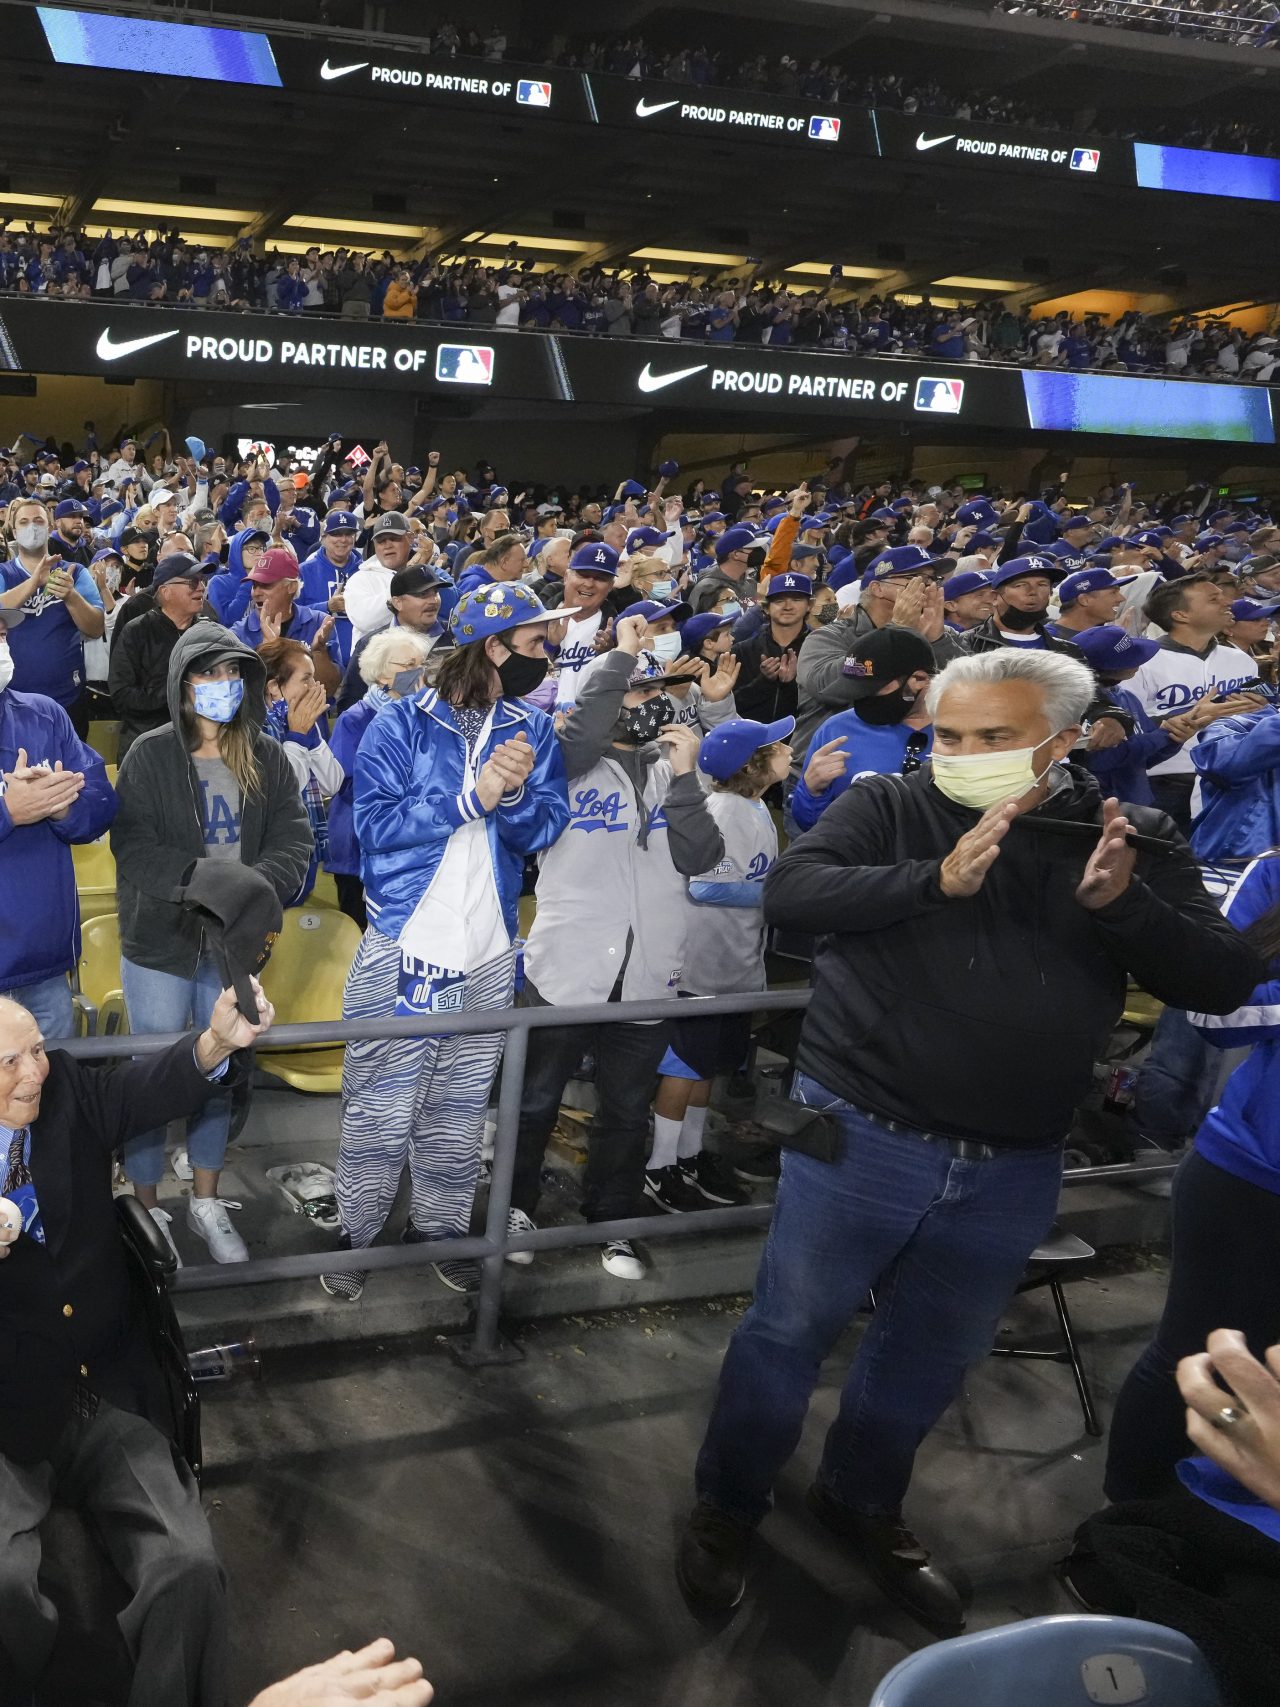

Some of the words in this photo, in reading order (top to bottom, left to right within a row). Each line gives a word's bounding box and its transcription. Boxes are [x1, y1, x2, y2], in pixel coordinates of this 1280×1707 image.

[371, 66, 423, 86] PROUD
[425, 73, 489, 95] PARTNER
[491, 81, 512, 97] OF
[680, 104, 727, 123] PROUD
[728, 110, 785, 130] PARTNER
[786, 117, 806, 132] OF
[955, 138, 997, 155] PROUD
[998, 143, 1050, 162] PARTNER
[1050, 149, 1068, 164] OF
[186, 335, 273, 363] PROUD
[280, 341, 388, 370] PARTNER
[393, 348, 427, 372] OF
[711, 369, 783, 394] PROUD
[787, 374, 876, 400] PARTNER
[880, 381, 909, 402] OF
[595, 549, 607, 564] LA
[784, 575, 796, 587] LA
[1156, 675, 1256, 710] Dodger
[199, 780, 241, 845] LA
[307, 918, 313, 926] 5
[1106, 1666, 1119, 1691] 1
